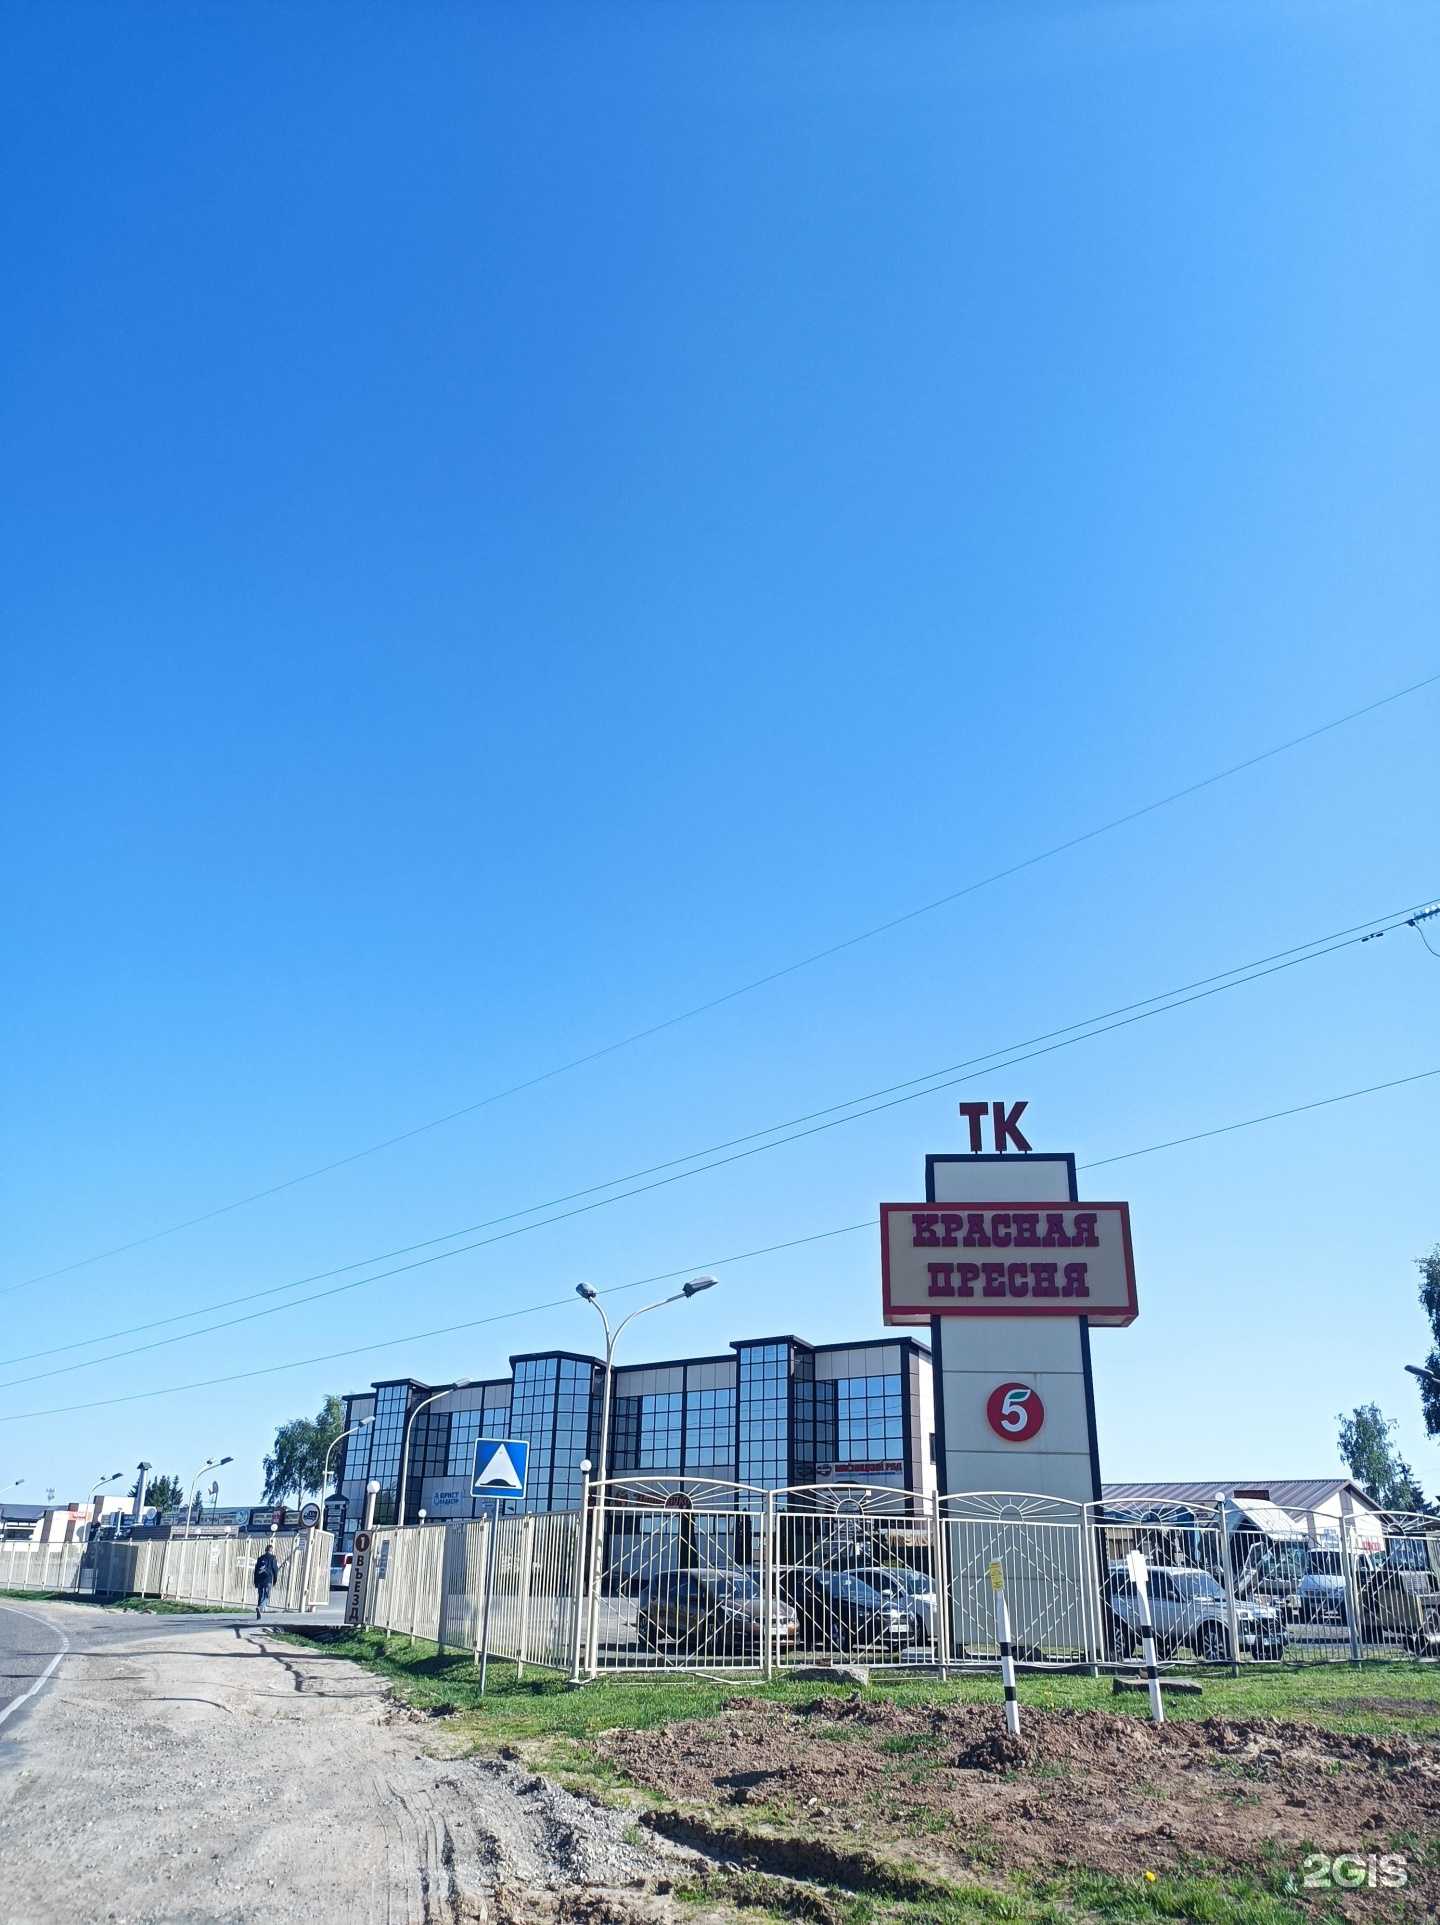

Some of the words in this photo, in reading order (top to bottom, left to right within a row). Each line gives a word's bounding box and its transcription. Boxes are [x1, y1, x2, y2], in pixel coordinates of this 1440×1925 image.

[959, 1101, 1033, 1152] ТК
[911, 1213, 1100, 1248] КРАСНАЯ
[927, 1262, 1090, 1298] ПРЕСНЯ
[1001, 1388, 1031, 1432] 5
[348, 1555, 365, 1621] ВЪЕЗД
